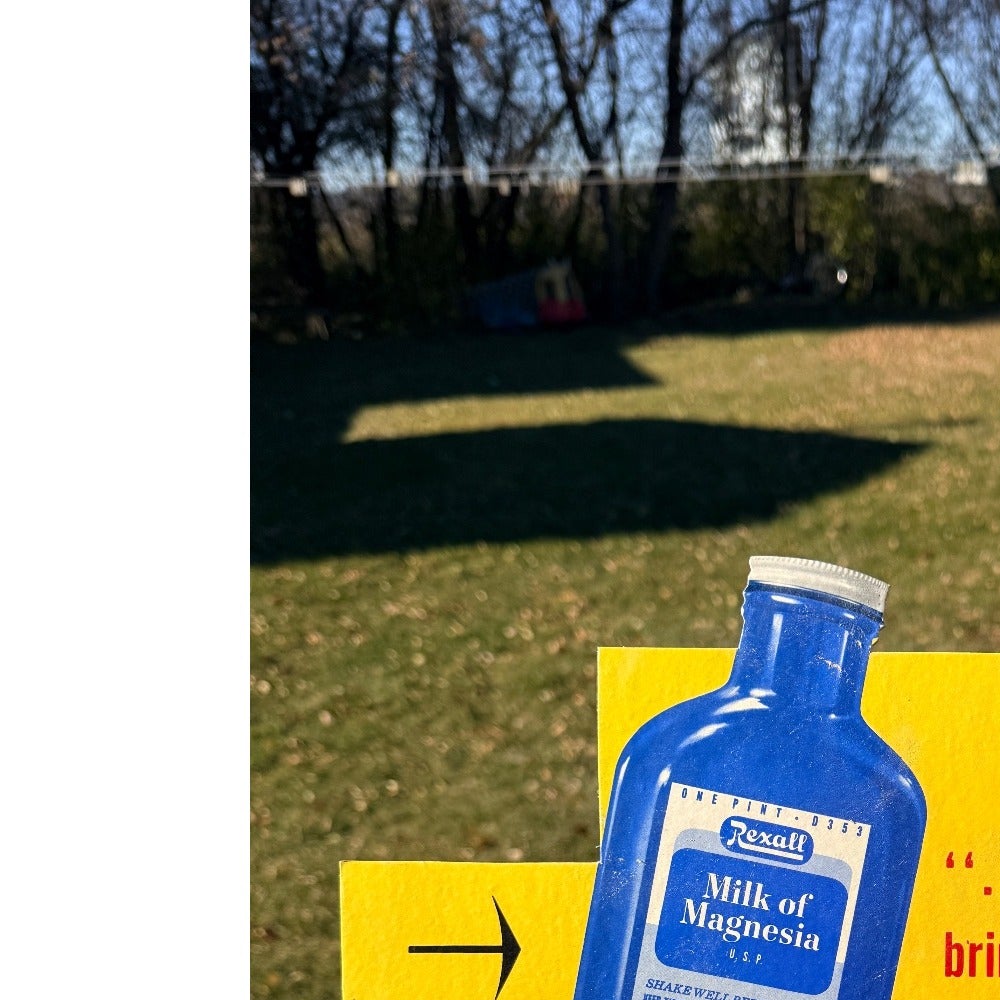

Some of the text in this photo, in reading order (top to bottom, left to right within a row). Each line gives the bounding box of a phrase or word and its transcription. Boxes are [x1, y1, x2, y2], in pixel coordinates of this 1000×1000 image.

[681, 787, 862, 836] ONE PINT D353
[726, 819, 807, 860] Rexall
[702, 872, 814, 919] Milk of
[679, 897, 819, 951] Magnesia
[645, 978, 692, 995] SHAKE
